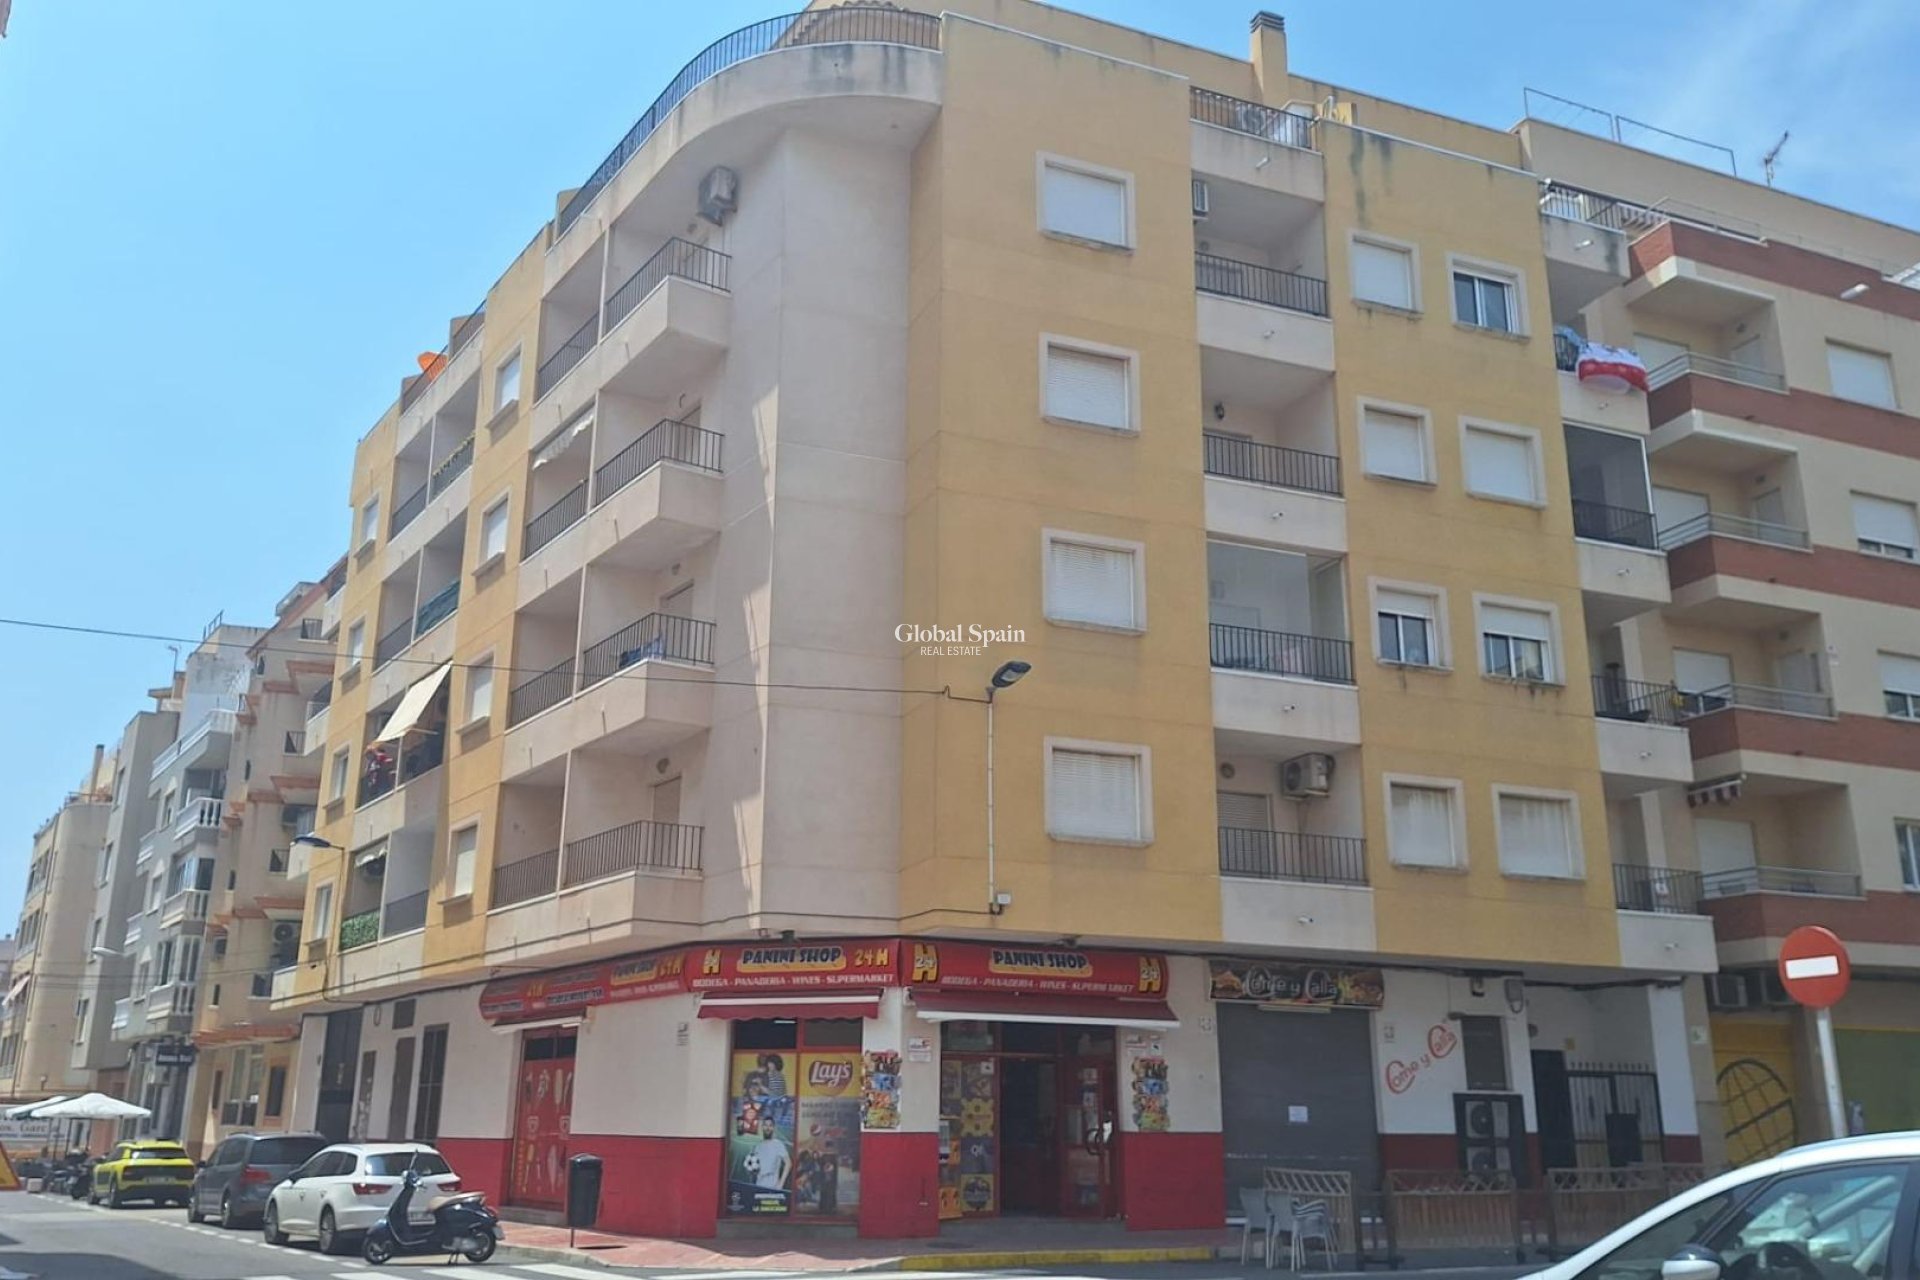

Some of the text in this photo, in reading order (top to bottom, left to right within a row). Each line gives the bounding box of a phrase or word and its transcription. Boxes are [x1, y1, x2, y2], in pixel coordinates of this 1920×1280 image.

[742, 949, 795, 965] PANINI
[799, 947, 842, 963] SHOP
[992, 951, 1088, 969] PANINI SHOP
[826, 974, 894, 984] SUPERMARKET
[1246, 964, 1287, 998] Come
[1304, 968, 1339, 1000] Calla
[1386, 1060, 1418, 1094] Come
[1427, 1024, 1458, 1059] Calla
[810, 1061, 852, 1087] Lay's
